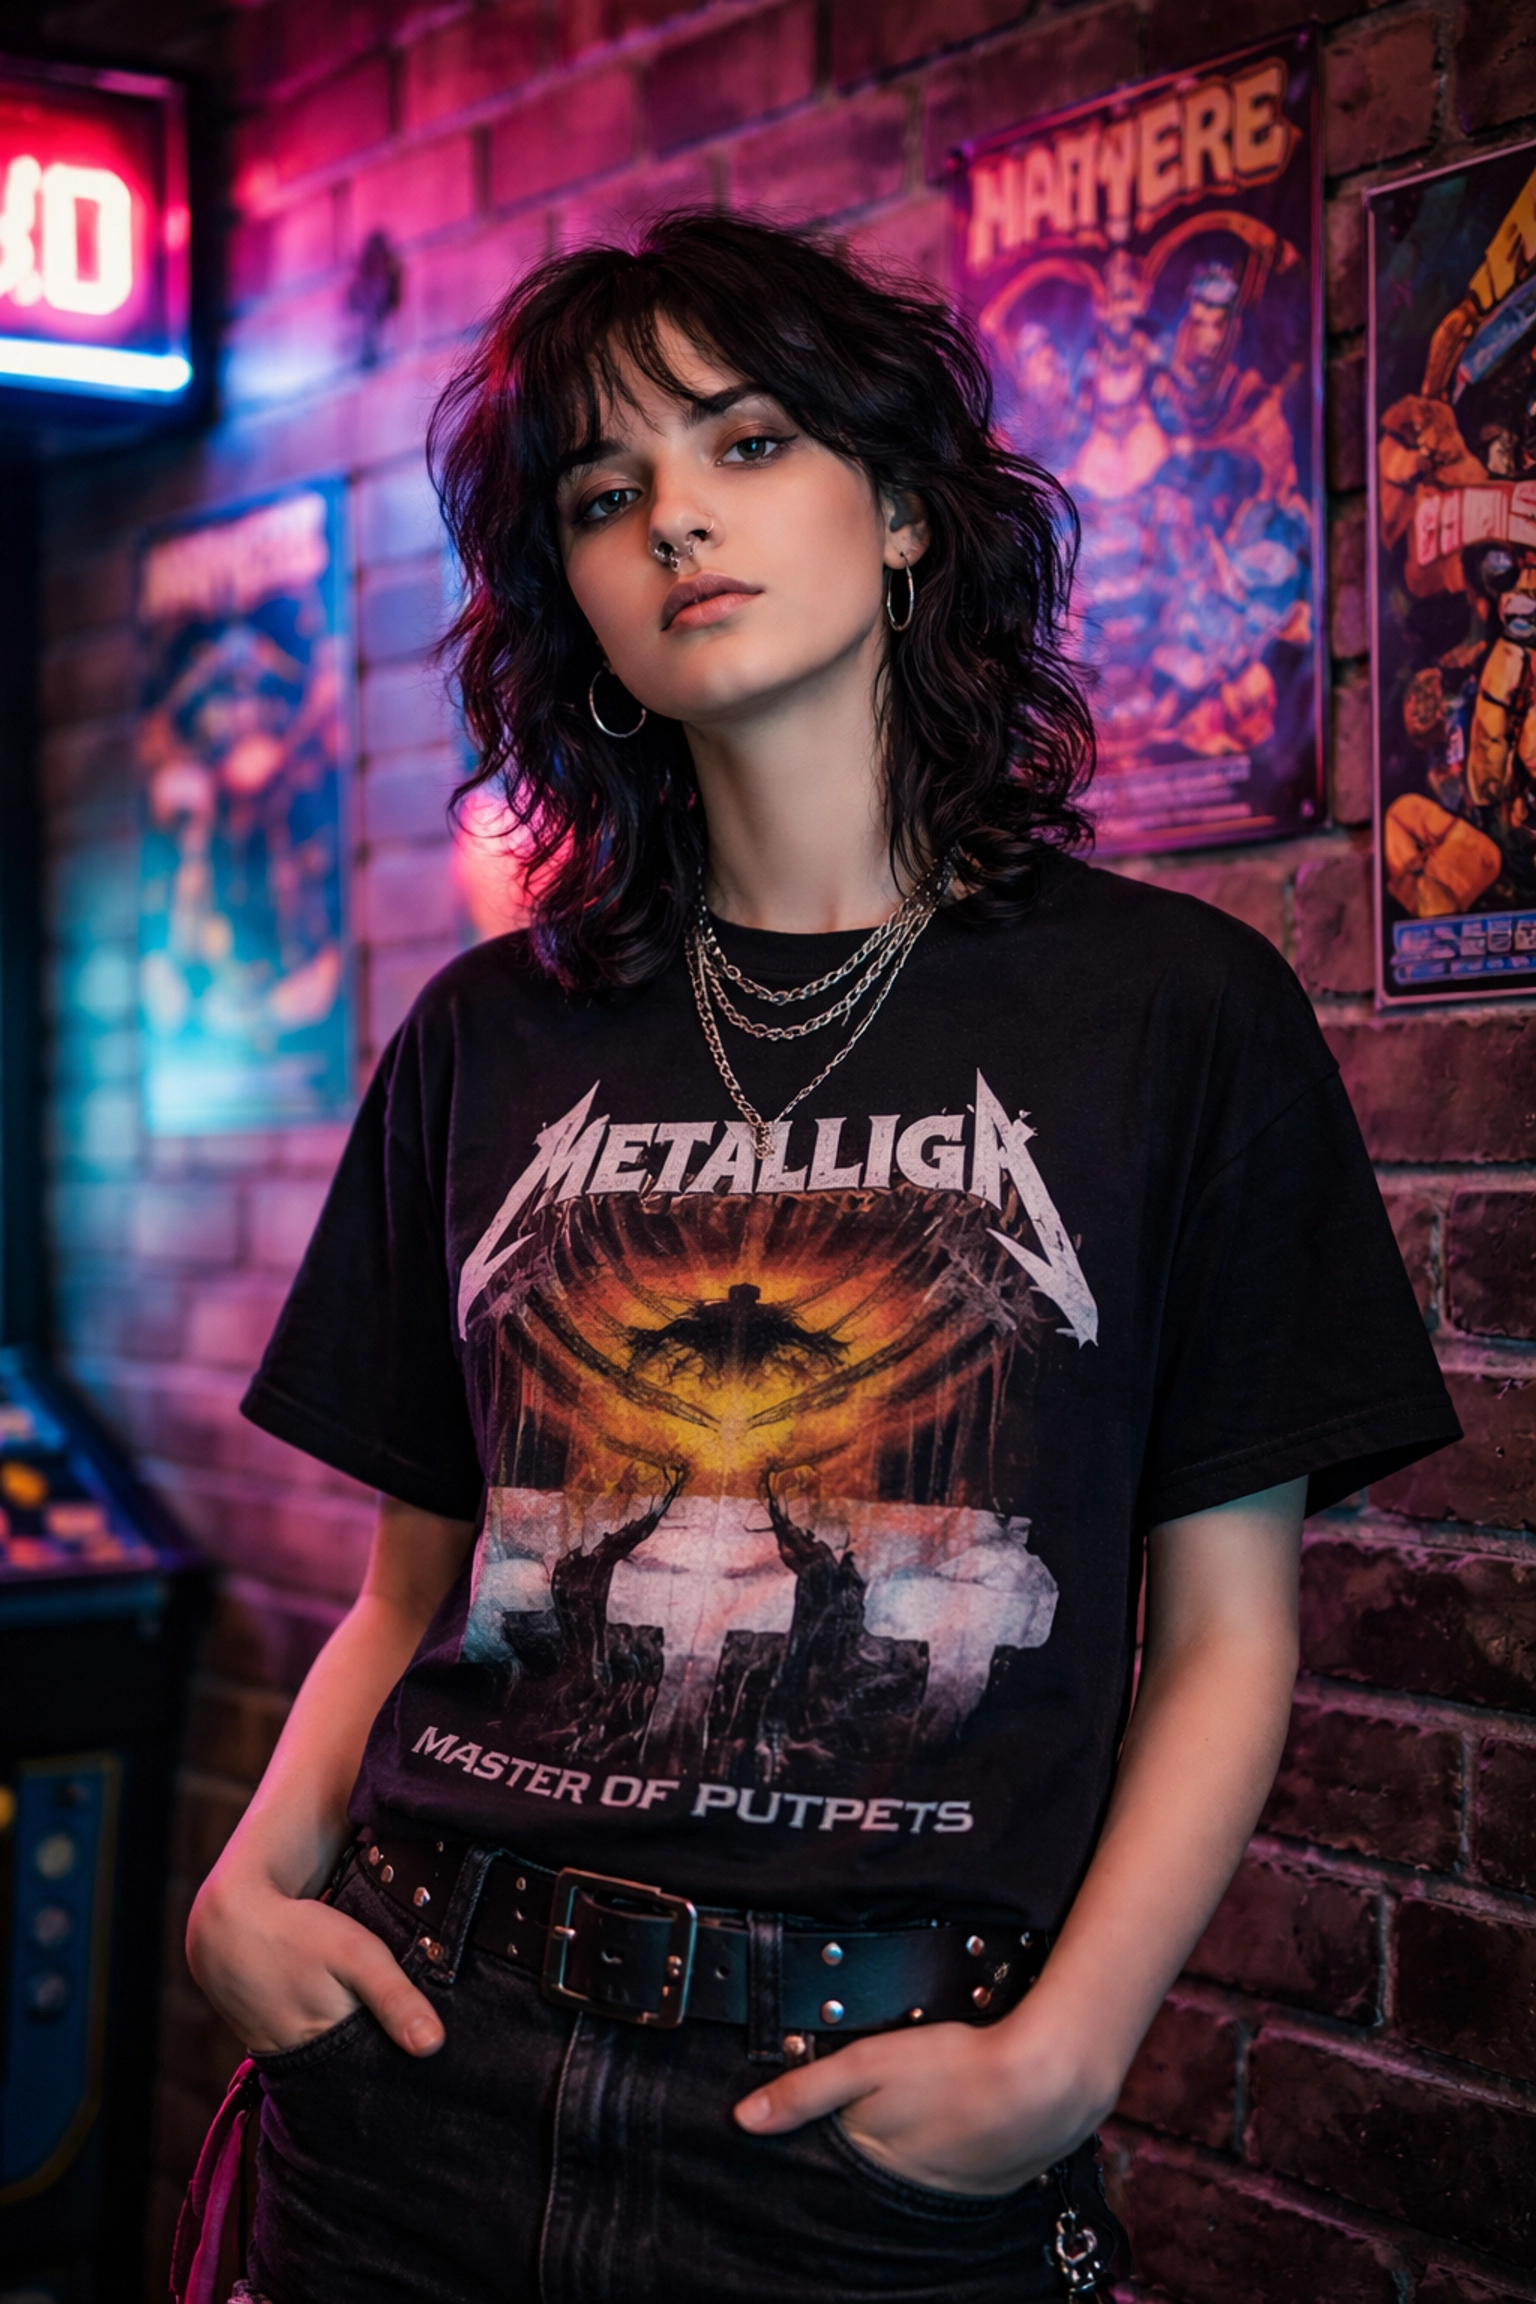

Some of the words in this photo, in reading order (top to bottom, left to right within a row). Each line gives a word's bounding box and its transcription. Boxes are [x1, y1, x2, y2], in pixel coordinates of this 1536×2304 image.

[411, 1725, 591, 1805] MASTER
[600, 1775, 680, 1810] OF
[691, 1783, 974, 1834] PUTPETS
